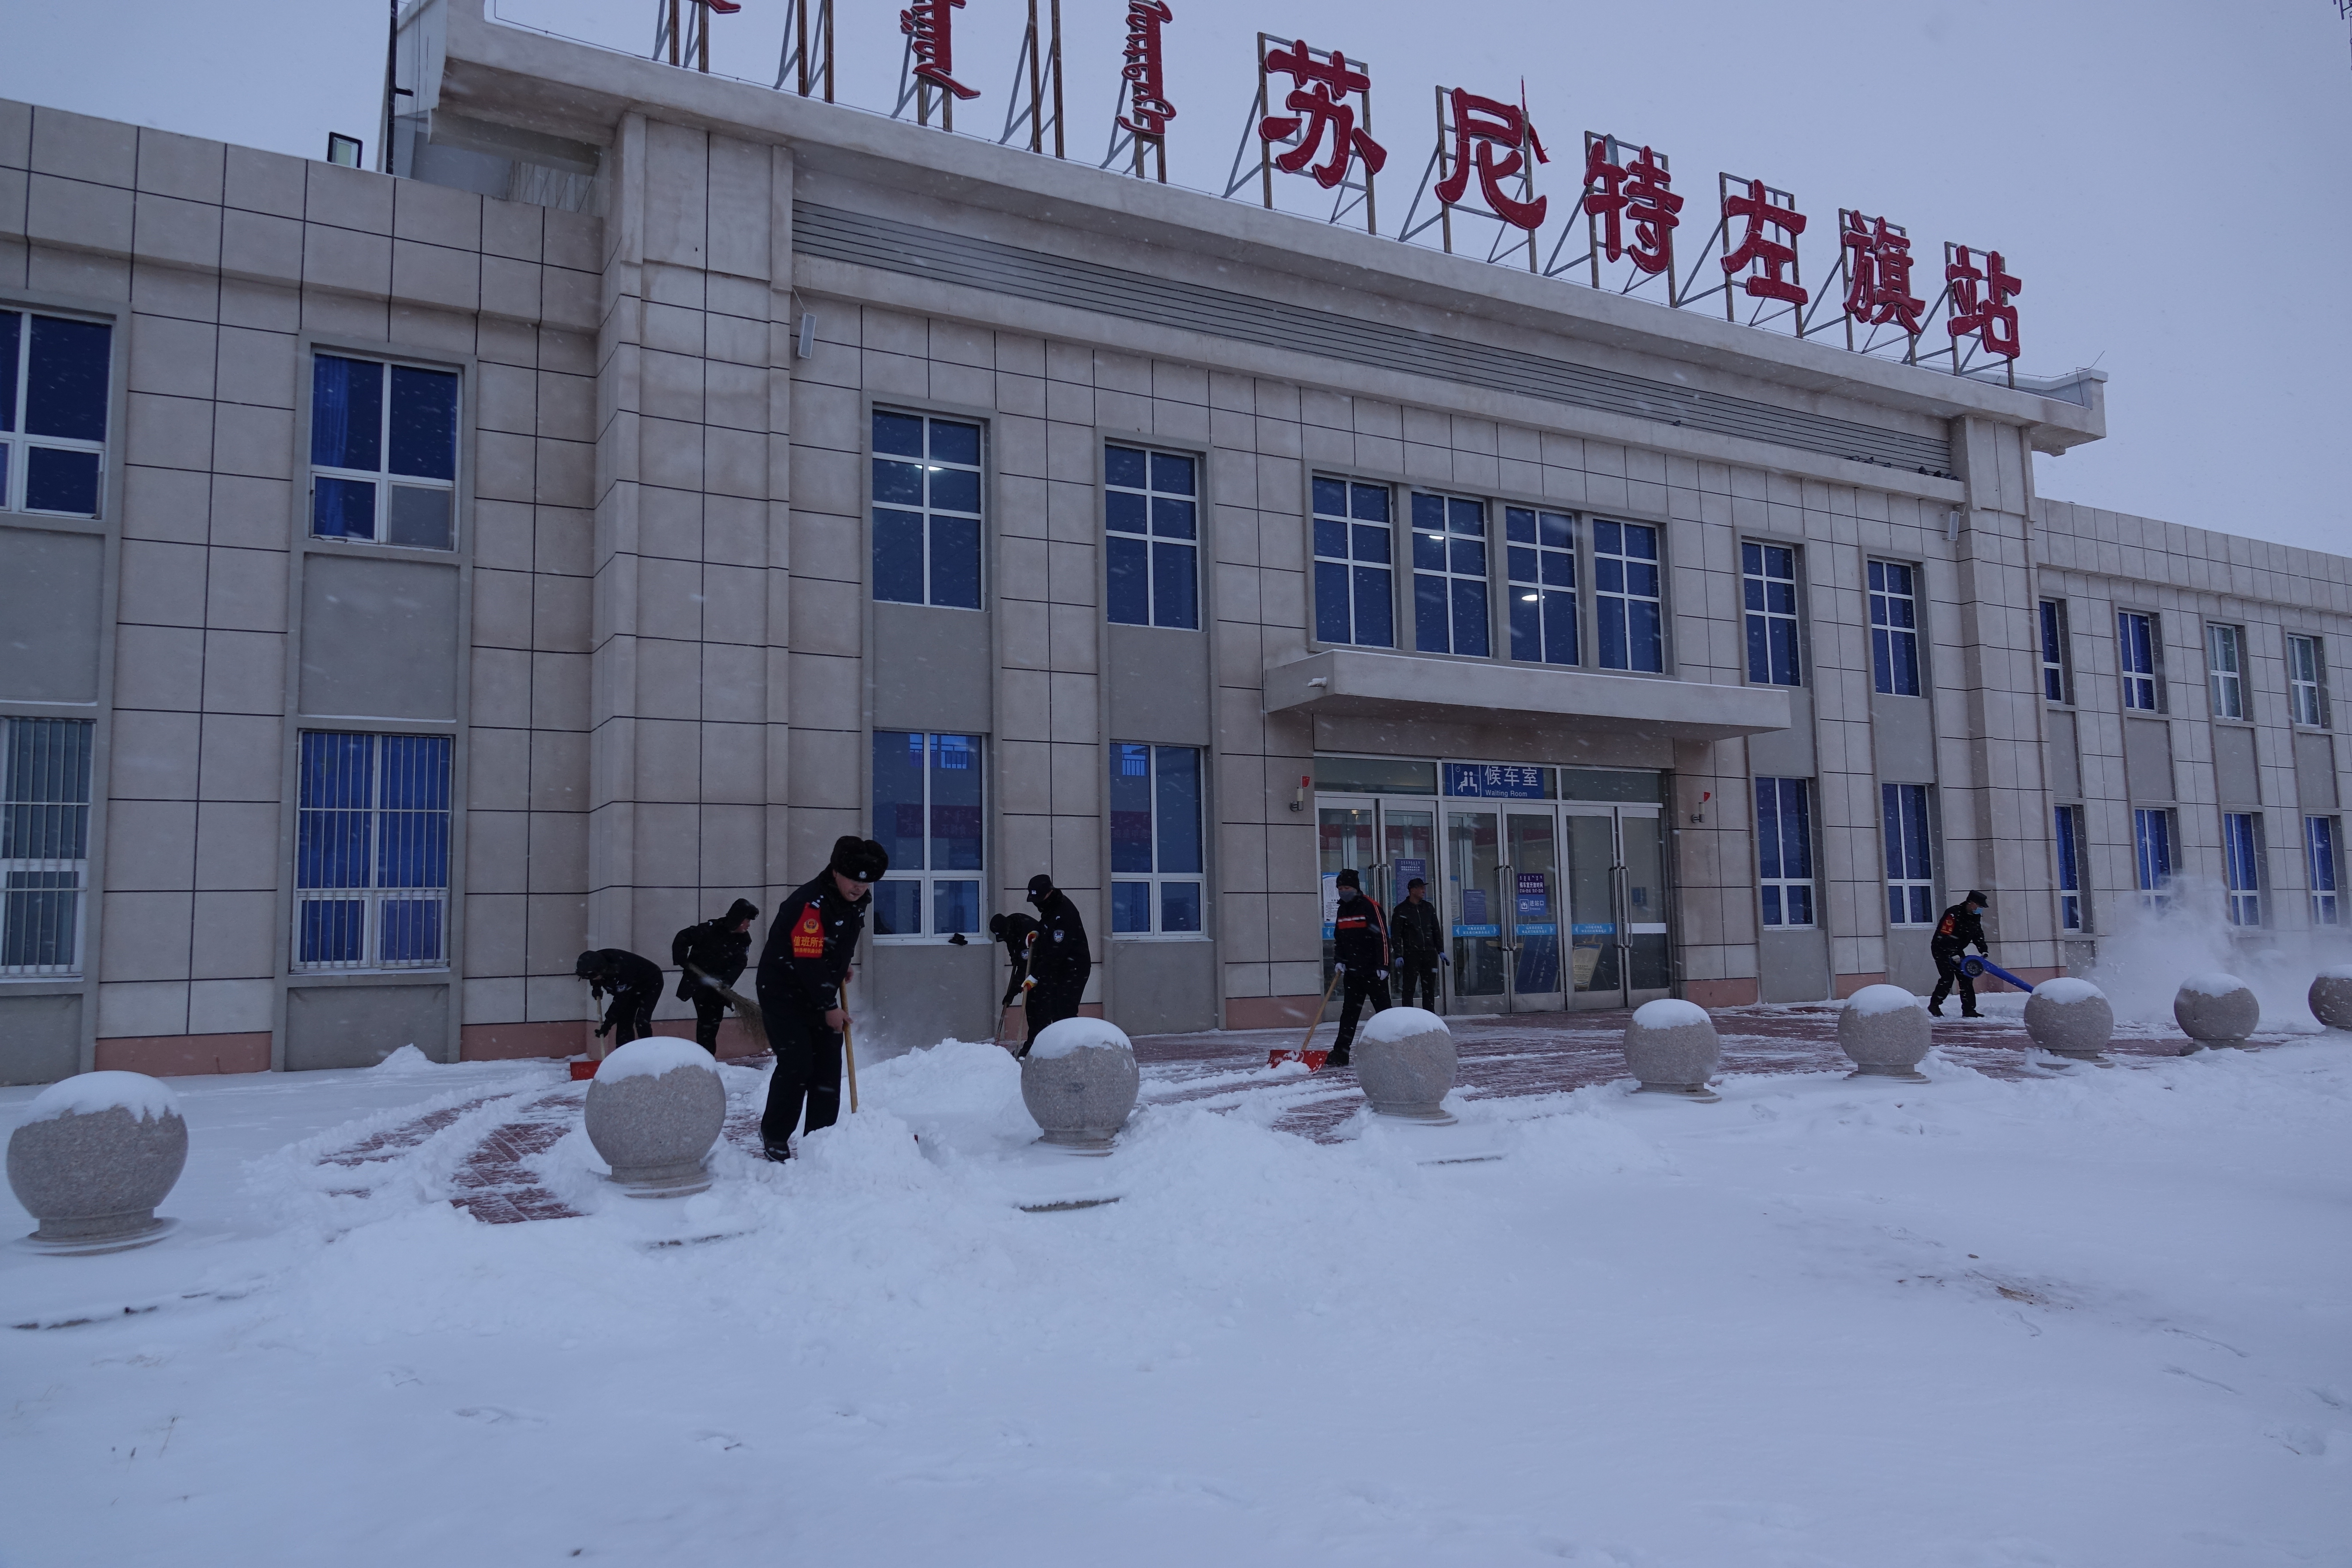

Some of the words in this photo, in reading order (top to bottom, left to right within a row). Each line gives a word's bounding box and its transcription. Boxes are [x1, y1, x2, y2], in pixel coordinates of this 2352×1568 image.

[1260, 39, 2022, 358] 苏尼特左旗站
[1485, 766, 1538, 786] 候车室
